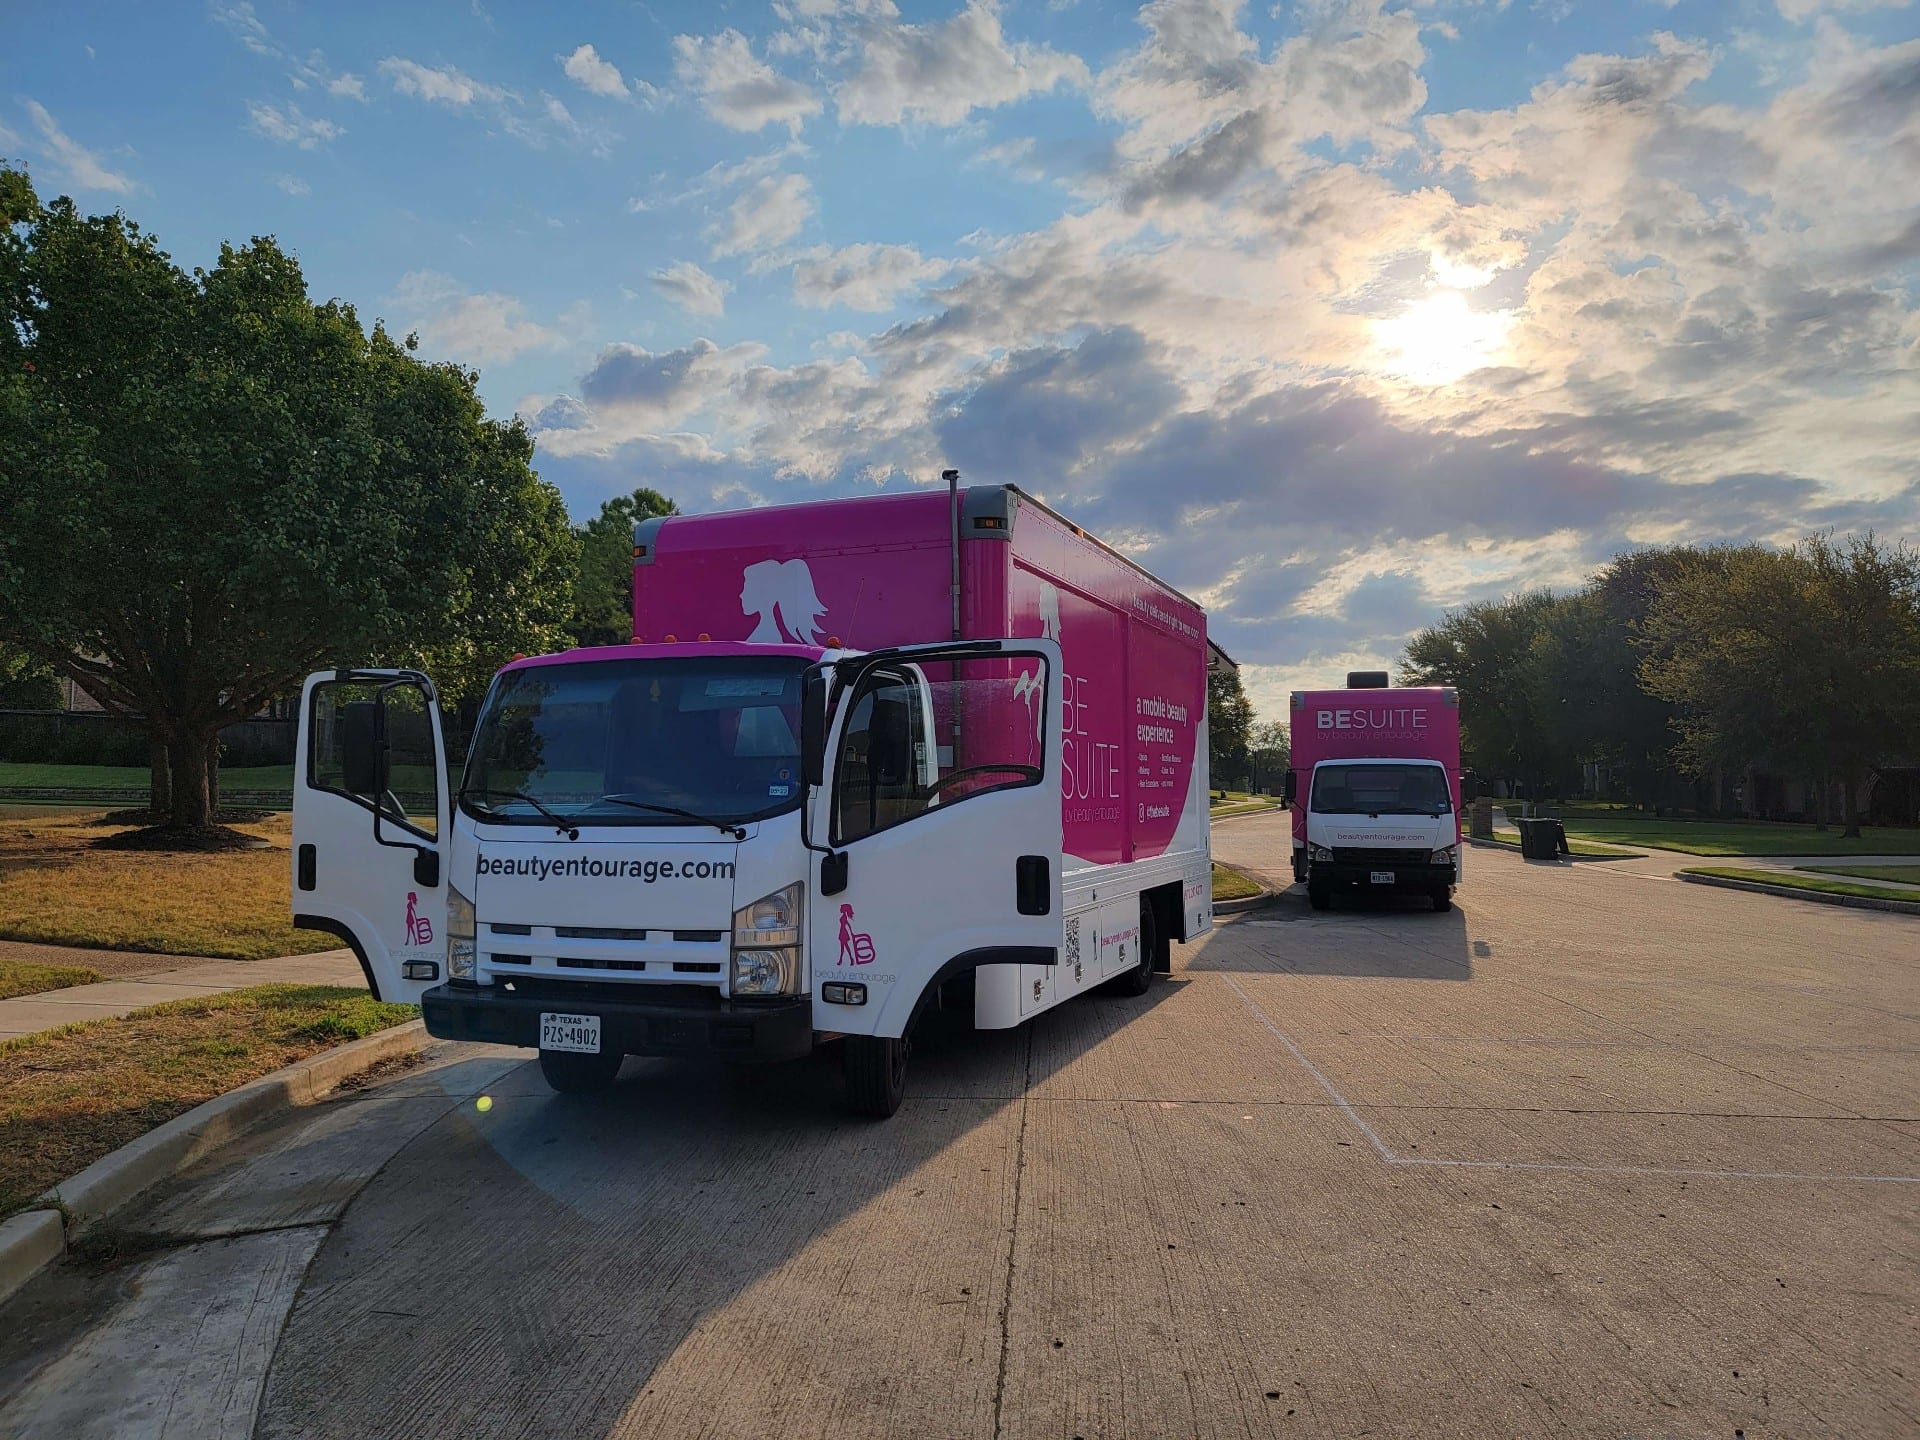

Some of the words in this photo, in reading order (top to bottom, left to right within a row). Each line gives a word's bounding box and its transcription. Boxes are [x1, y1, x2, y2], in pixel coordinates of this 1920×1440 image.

[1061, 673, 1088, 735] BE
[1136, 697, 1142, 714] a
[1142, 696, 1166, 719] mobile
[1166, 698, 1188, 727] beauty
[1137, 721, 1174, 747] experience
[1331, 730, 1371, 741] beauty
[1061, 739, 1120, 800] SUITE
[1336, 832, 1426, 842] beautyentourage.com
[476, 853, 736, 884] beautyentourage.com
[814, 967, 848, 981] beauty
[848, 971, 896, 984] entourage
[558, 1016, 582, 1025] TEXAS
